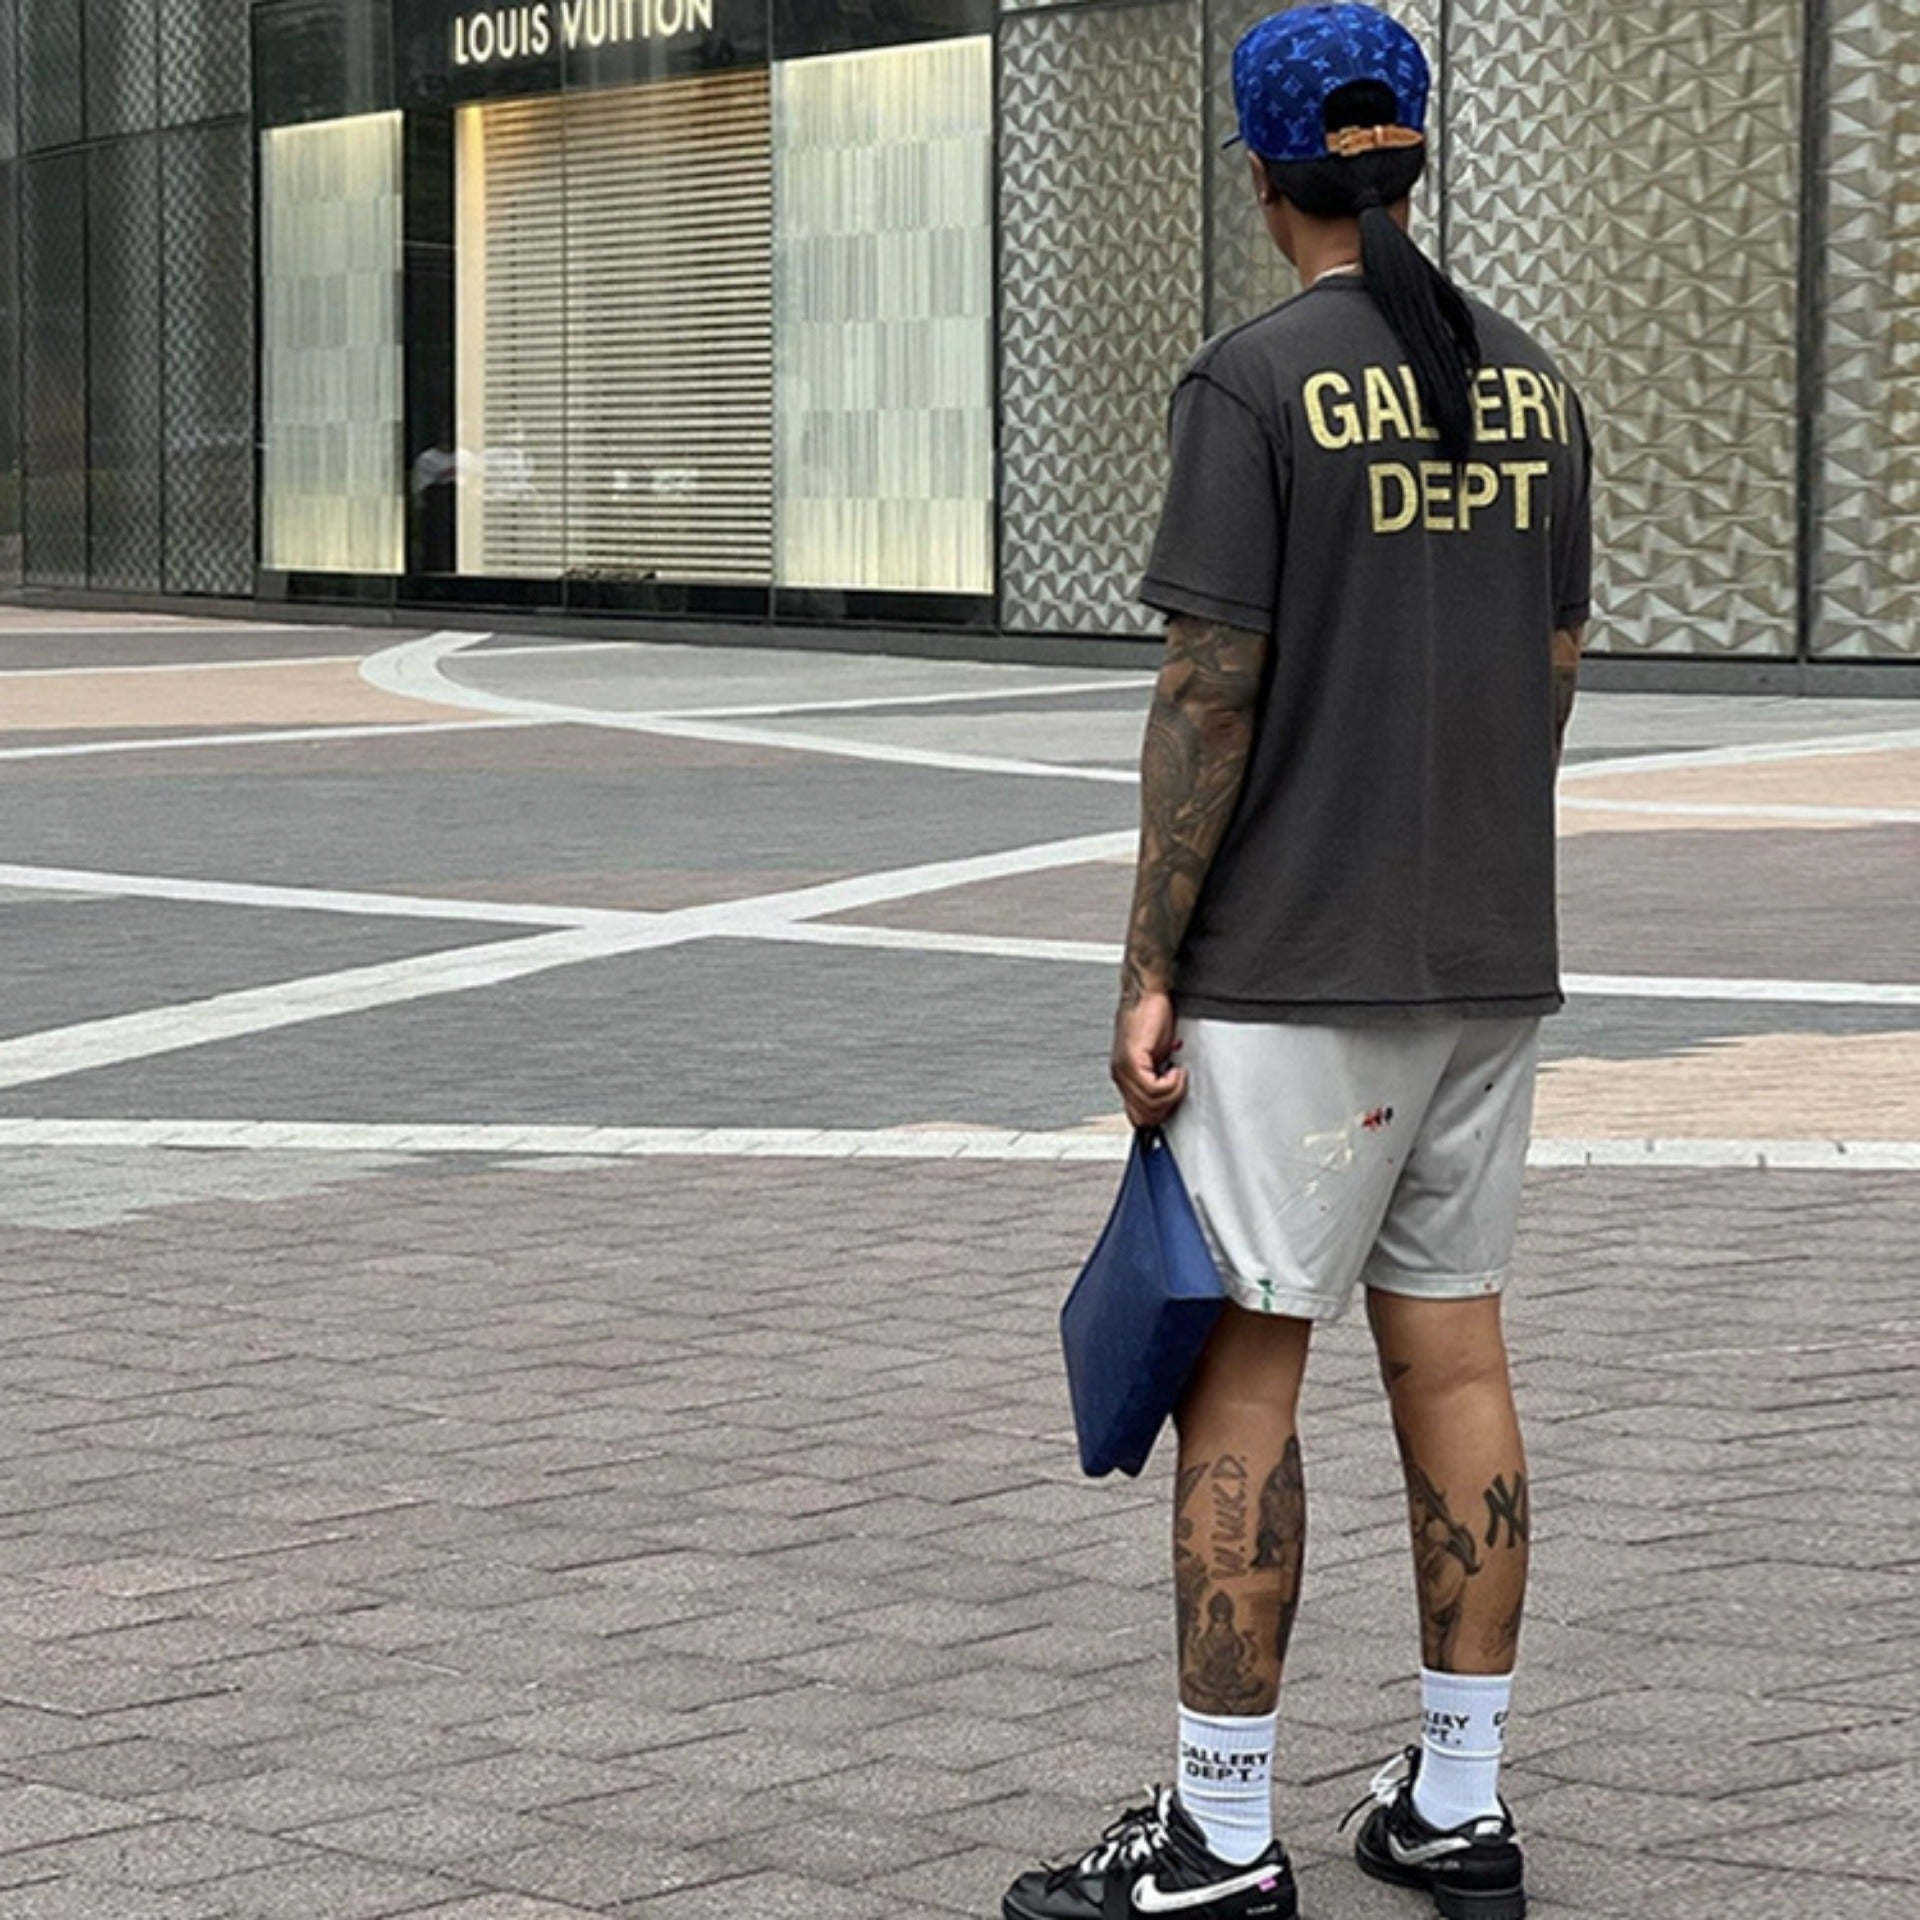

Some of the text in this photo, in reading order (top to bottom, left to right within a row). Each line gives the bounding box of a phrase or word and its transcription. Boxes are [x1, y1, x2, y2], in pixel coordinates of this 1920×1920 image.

[455, 0, 713, 64] LOUIS VUITTON
[1303, 365, 1569, 449] GALERY
